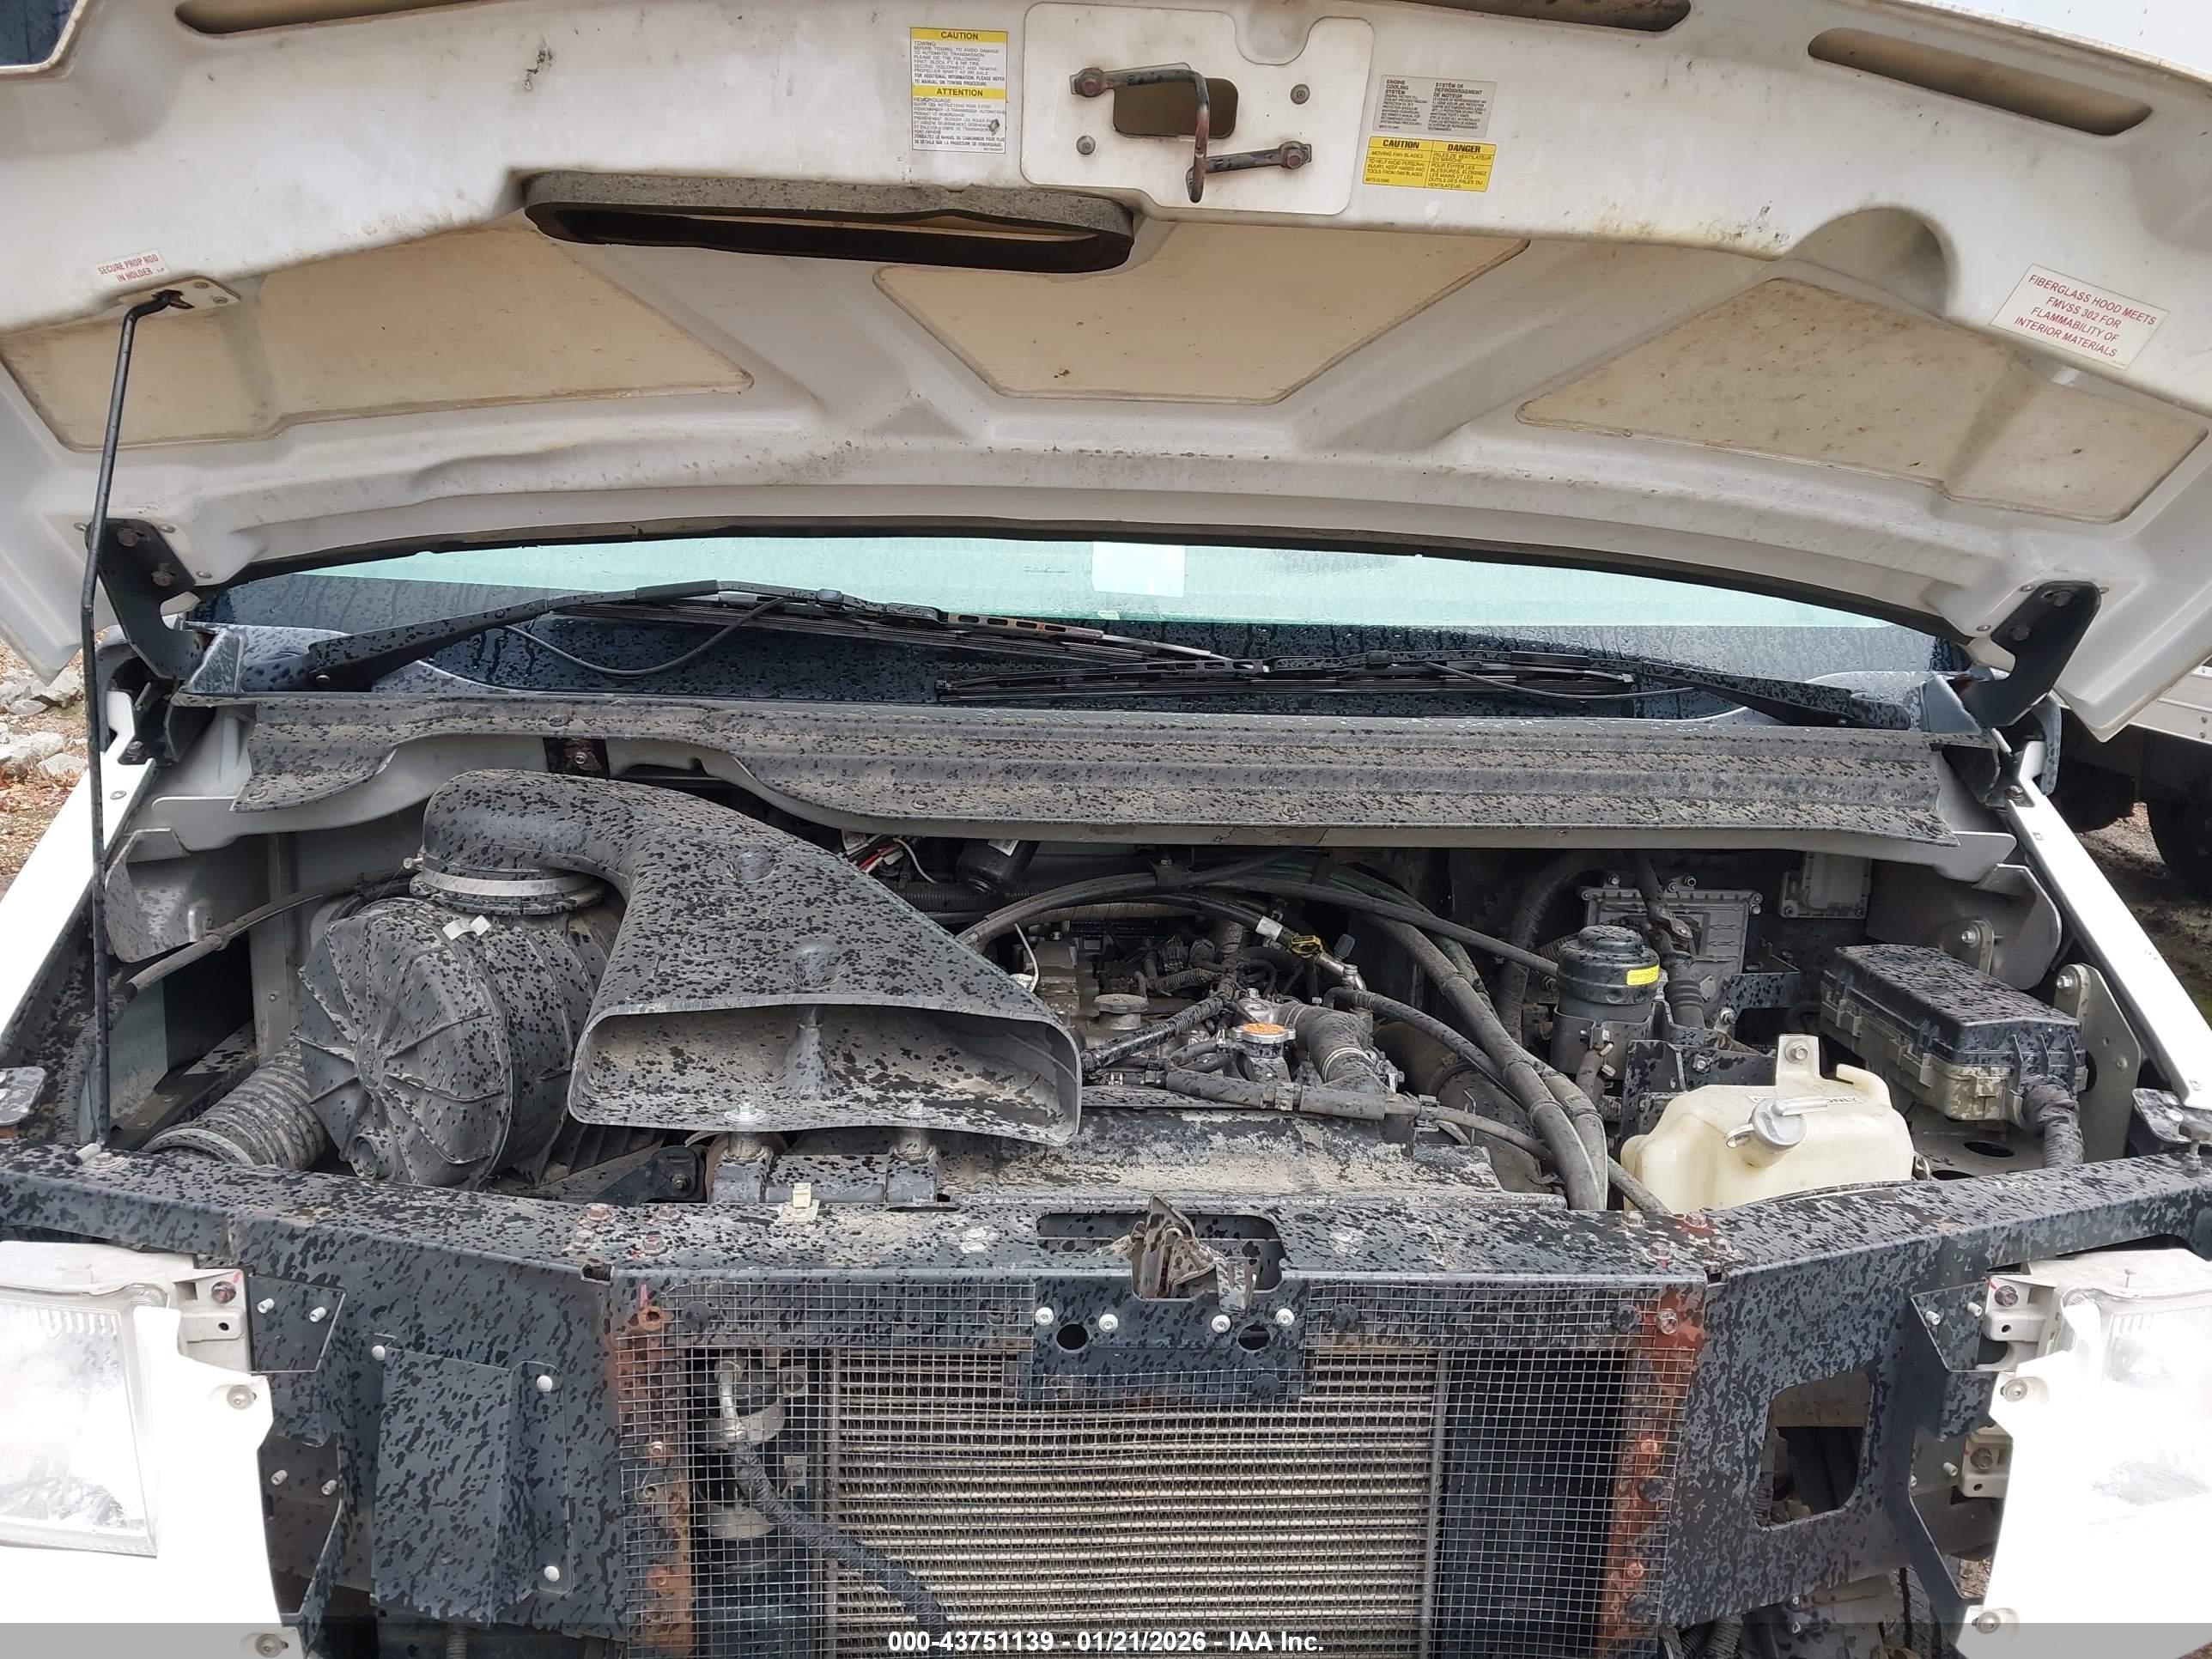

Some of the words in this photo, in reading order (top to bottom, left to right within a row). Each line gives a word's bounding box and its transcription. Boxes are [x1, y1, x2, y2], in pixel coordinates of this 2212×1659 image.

[1382, 139, 1419, 149] CAUTION
[1448, 144, 1481, 153] DANGER
[98, 262, 125, 274] SECURE
[124, 258, 143, 268] PROP
[143, 254, 159, 264] ROD
[125, 267, 153, 279] HOLDER
[2028, 274, 2092, 303] FIBERGLASS
[2092, 297, 2122, 313] HOOD
[2122, 307, 2157, 325] MEETS
[2046, 296, 2081, 313] FMVSS
[2081, 308, 2100, 321] 302
[2100, 315, 2122, 329] FOR
[2014, 316, 2063, 339] INTERIOR
[2062, 332, 2118, 357] MATERIALS
[2031, 307, 2104, 337] FLAMMABILITY
[2104, 331, 2120, 342] OF
